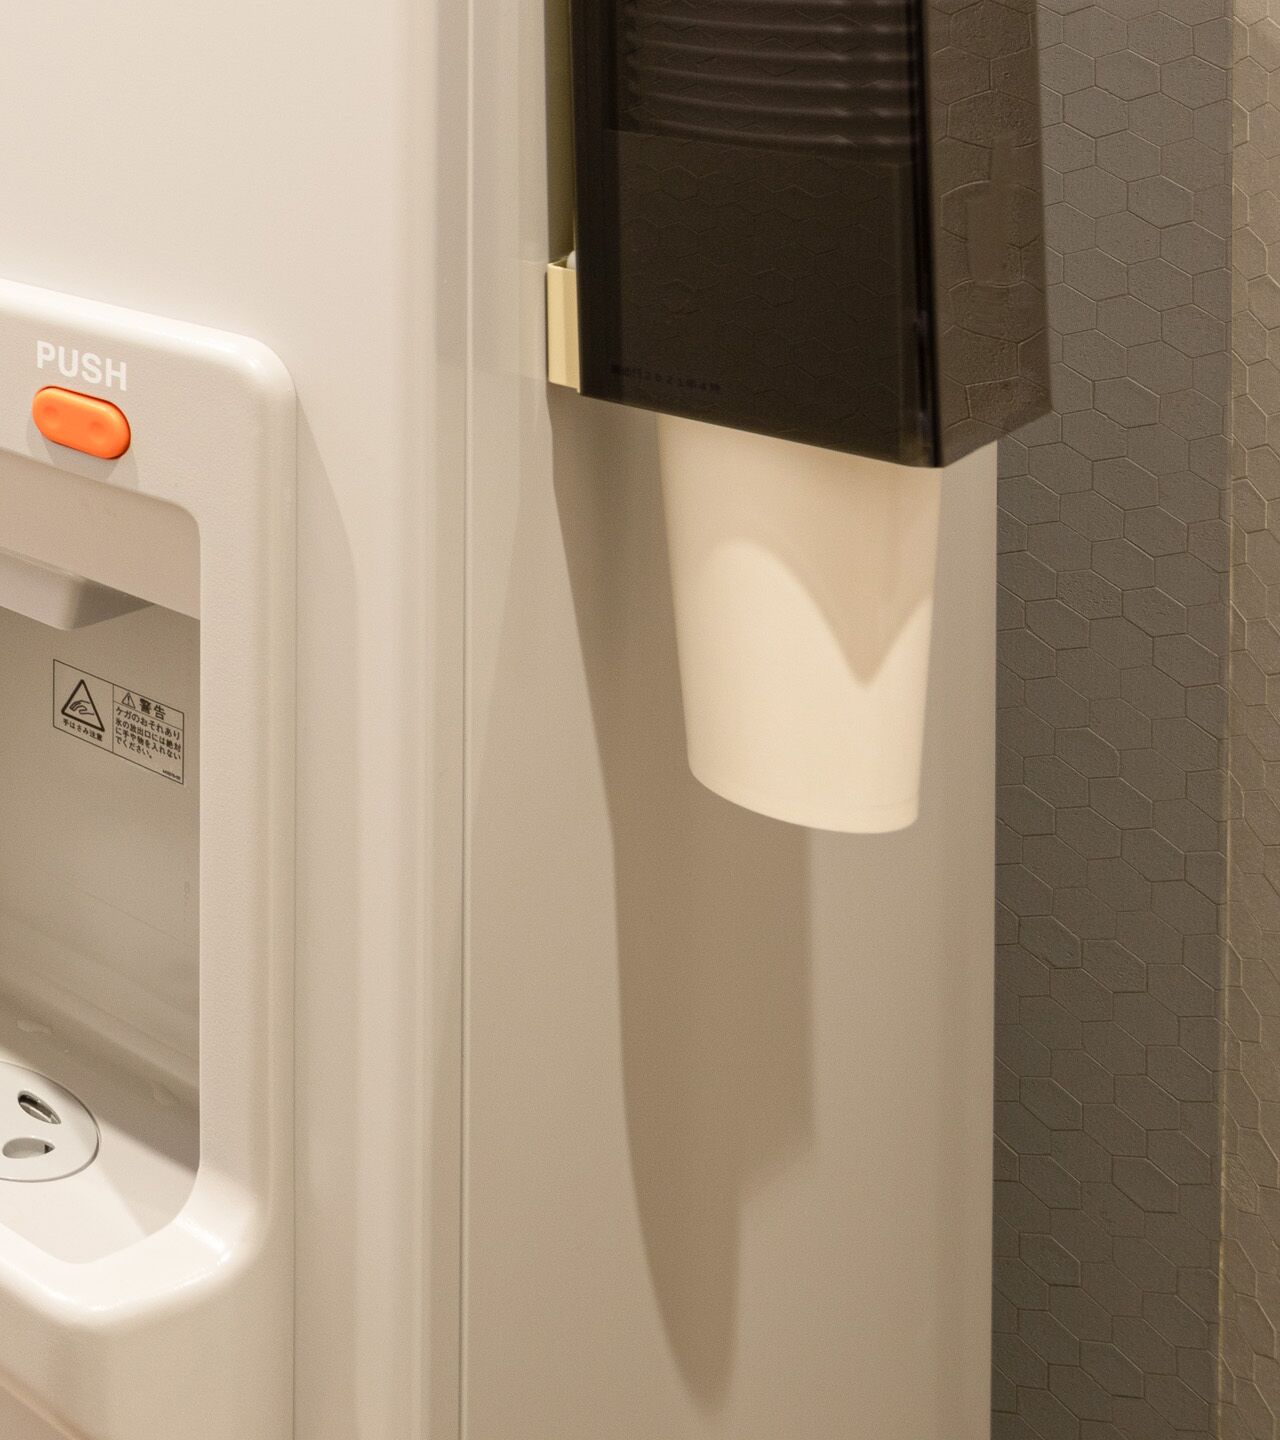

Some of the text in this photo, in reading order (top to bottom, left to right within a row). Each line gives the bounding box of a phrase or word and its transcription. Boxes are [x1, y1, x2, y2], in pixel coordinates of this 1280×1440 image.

[35, 340, 128, 391] PUSH
[115, 706, 181, 740] ケガのおそれあり
[139, 698, 166, 721] 警告
[62, 718, 103, 742] 手はさみ注意
[115, 717, 182, 752] 氷の放出口には絶対
[115, 726, 182, 760] に手や物を入れない
[115, 735, 153, 759] でください。
